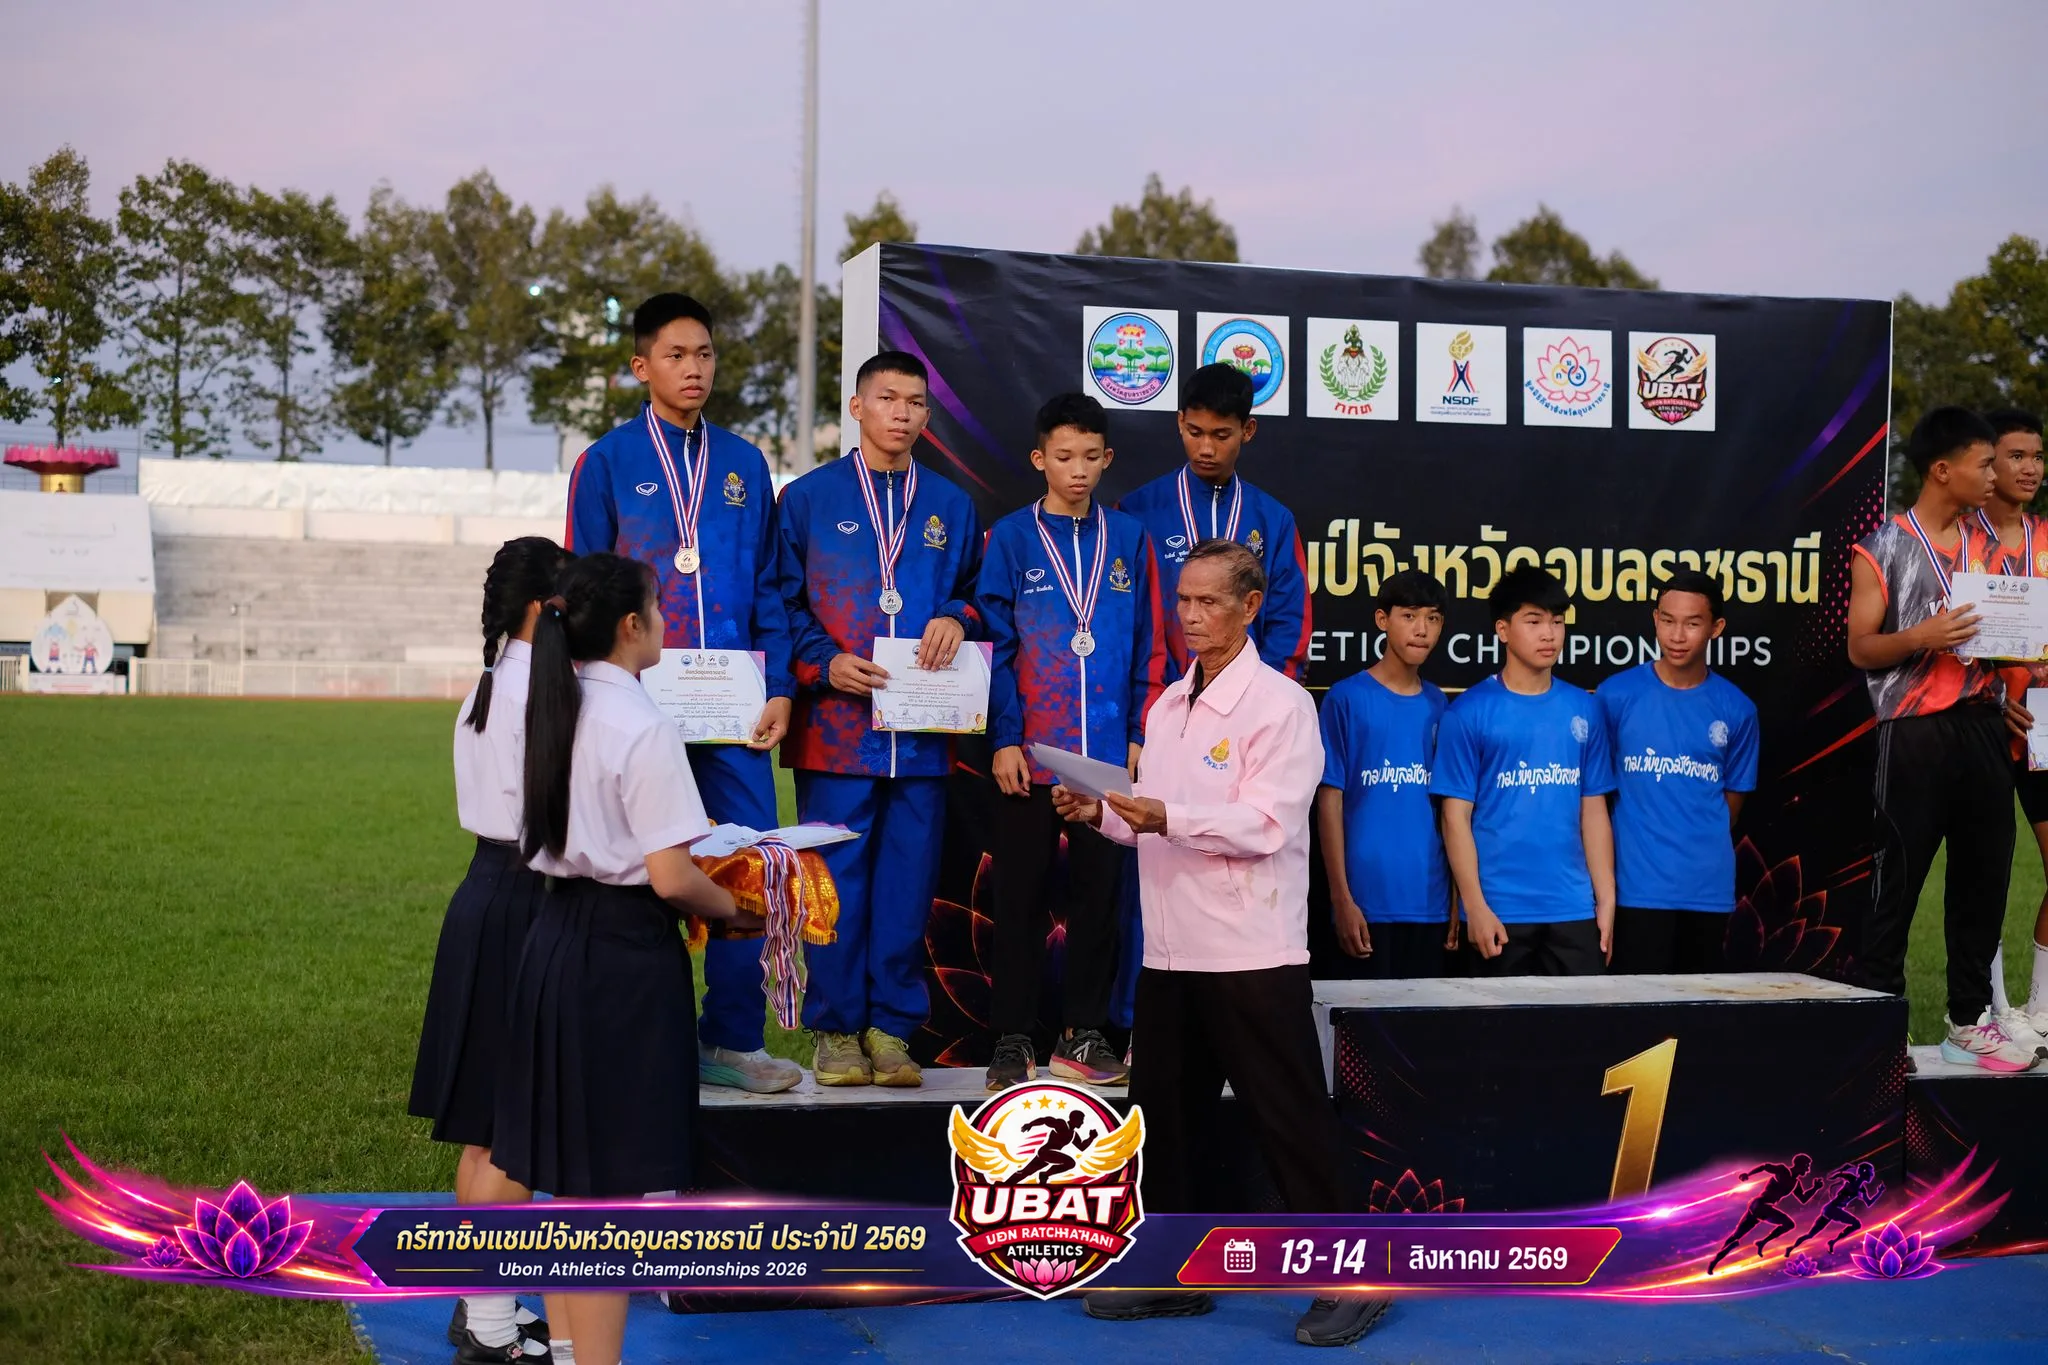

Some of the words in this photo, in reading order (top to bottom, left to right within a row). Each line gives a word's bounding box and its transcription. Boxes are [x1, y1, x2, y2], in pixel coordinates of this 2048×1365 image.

[1442, 395, 1479, 406] NSDF
[1642, 382, 1702, 401] UBAT
[1448, 632, 1772, 667] CHPIONIPS
[1600, 1039, 1678, 1205] 1
